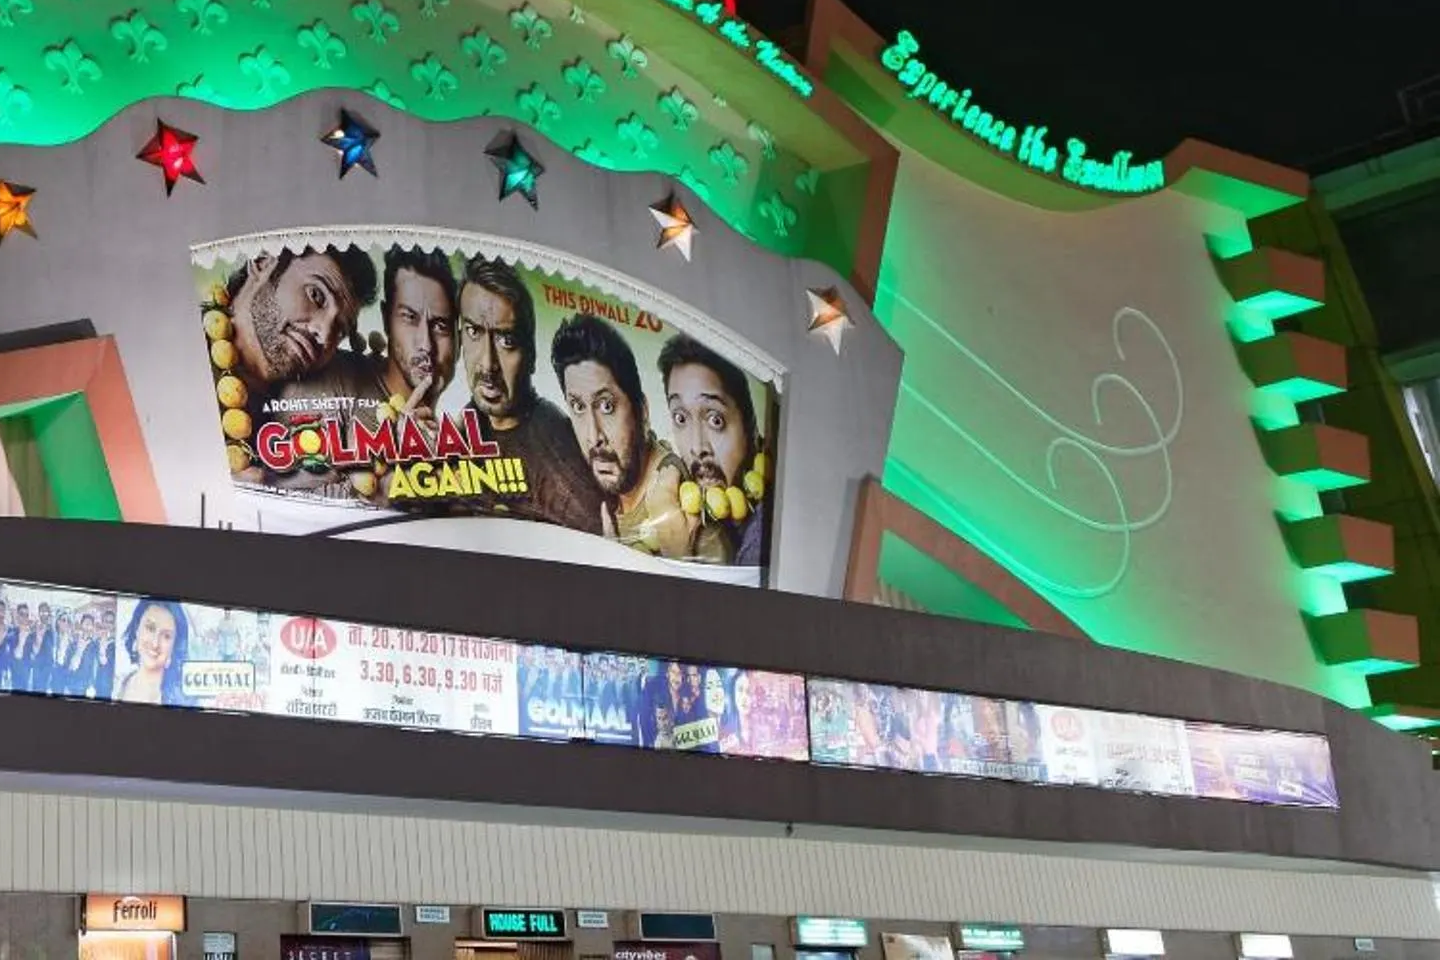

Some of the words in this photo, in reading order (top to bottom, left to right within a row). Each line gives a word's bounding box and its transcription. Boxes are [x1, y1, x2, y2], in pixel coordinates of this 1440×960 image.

[882, 30, 1016, 151] Experience
[1018, 125, 1058, 172] the
[542, 283, 576, 310] THIS
[578, 295, 630, 325] DIWALI
[263, 403, 271, 413] A
[271, 398, 308, 412] ROHIT
[310, 397, 356, 411] SHETTY
[358, 398, 380, 408] FILM
[257, 408, 500, 470] GOLMAAL
[388, 458, 528, 498] AGAIN!!!
[113, 899, 158, 922] Ferroli
[488, 912, 526, 931] HOUSE
[528, 913, 557, 932] FULL
